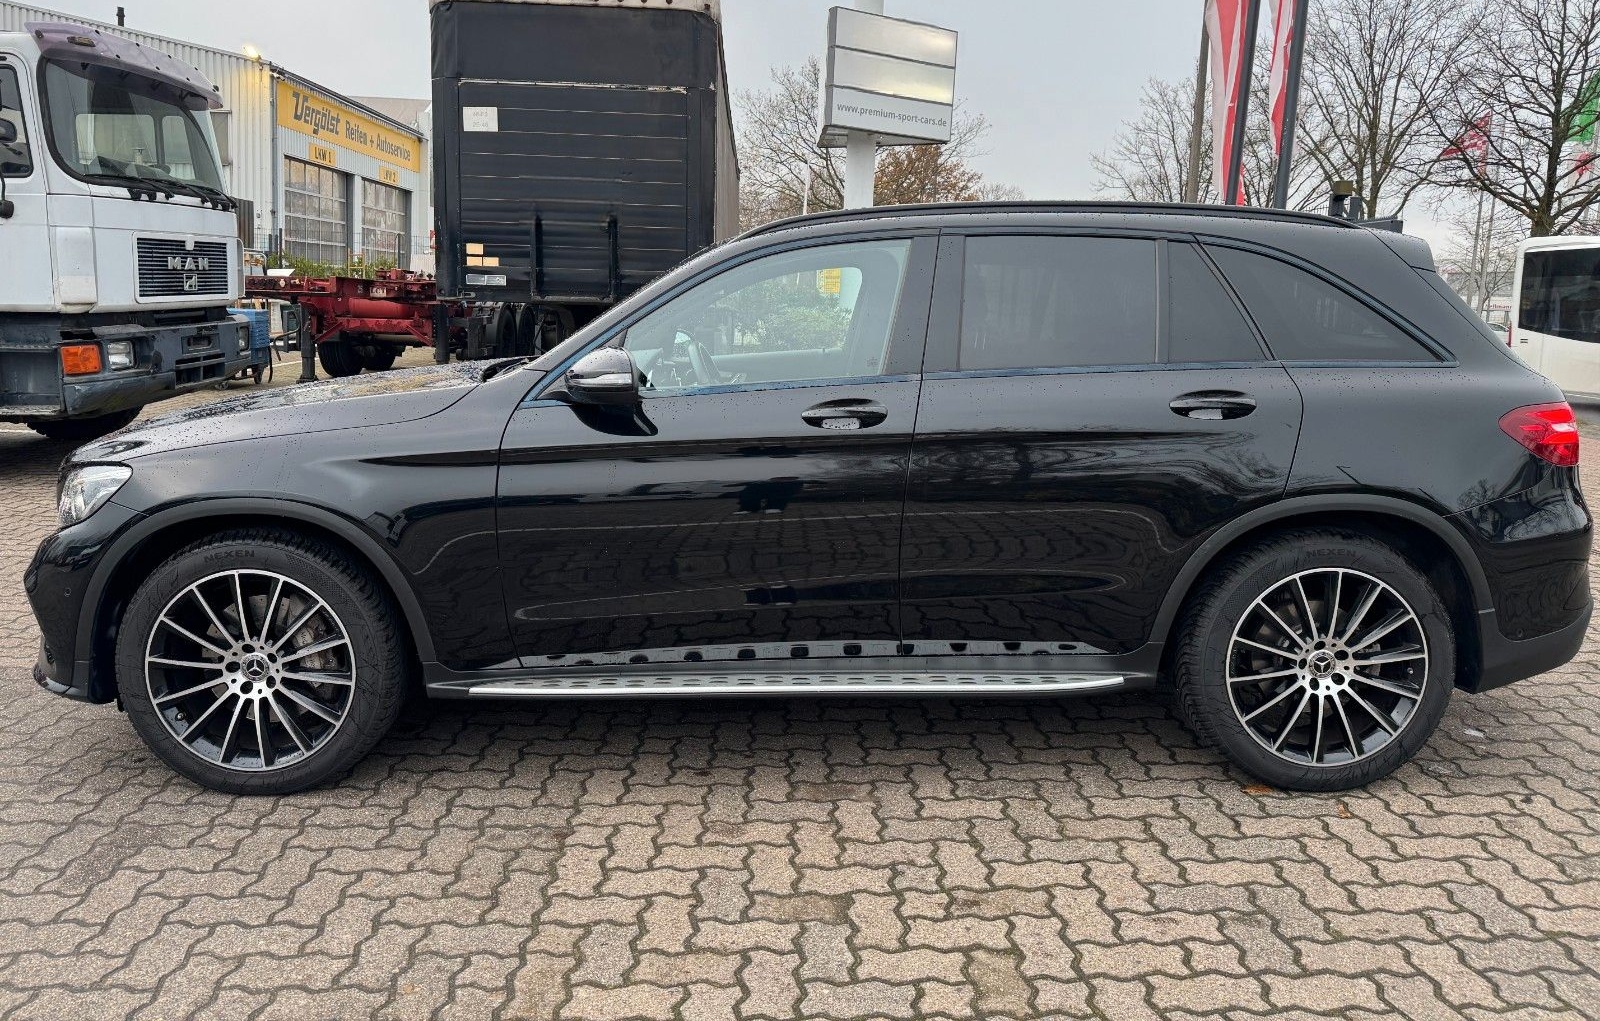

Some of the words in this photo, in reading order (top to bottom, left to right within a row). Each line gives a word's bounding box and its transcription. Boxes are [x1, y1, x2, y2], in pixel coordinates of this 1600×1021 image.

[837, 103, 947, 127] www.premium-sport-cars.de
[293, 91, 340, 136] Vergölst
[345, 119, 368, 146] Reifen
[376, 133, 411, 161] Autoservice
[168, 256, 209, 270] MAN
[204, 550, 255, 563] NEXEN
[1306, 548, 1357, 557] NEXEN
